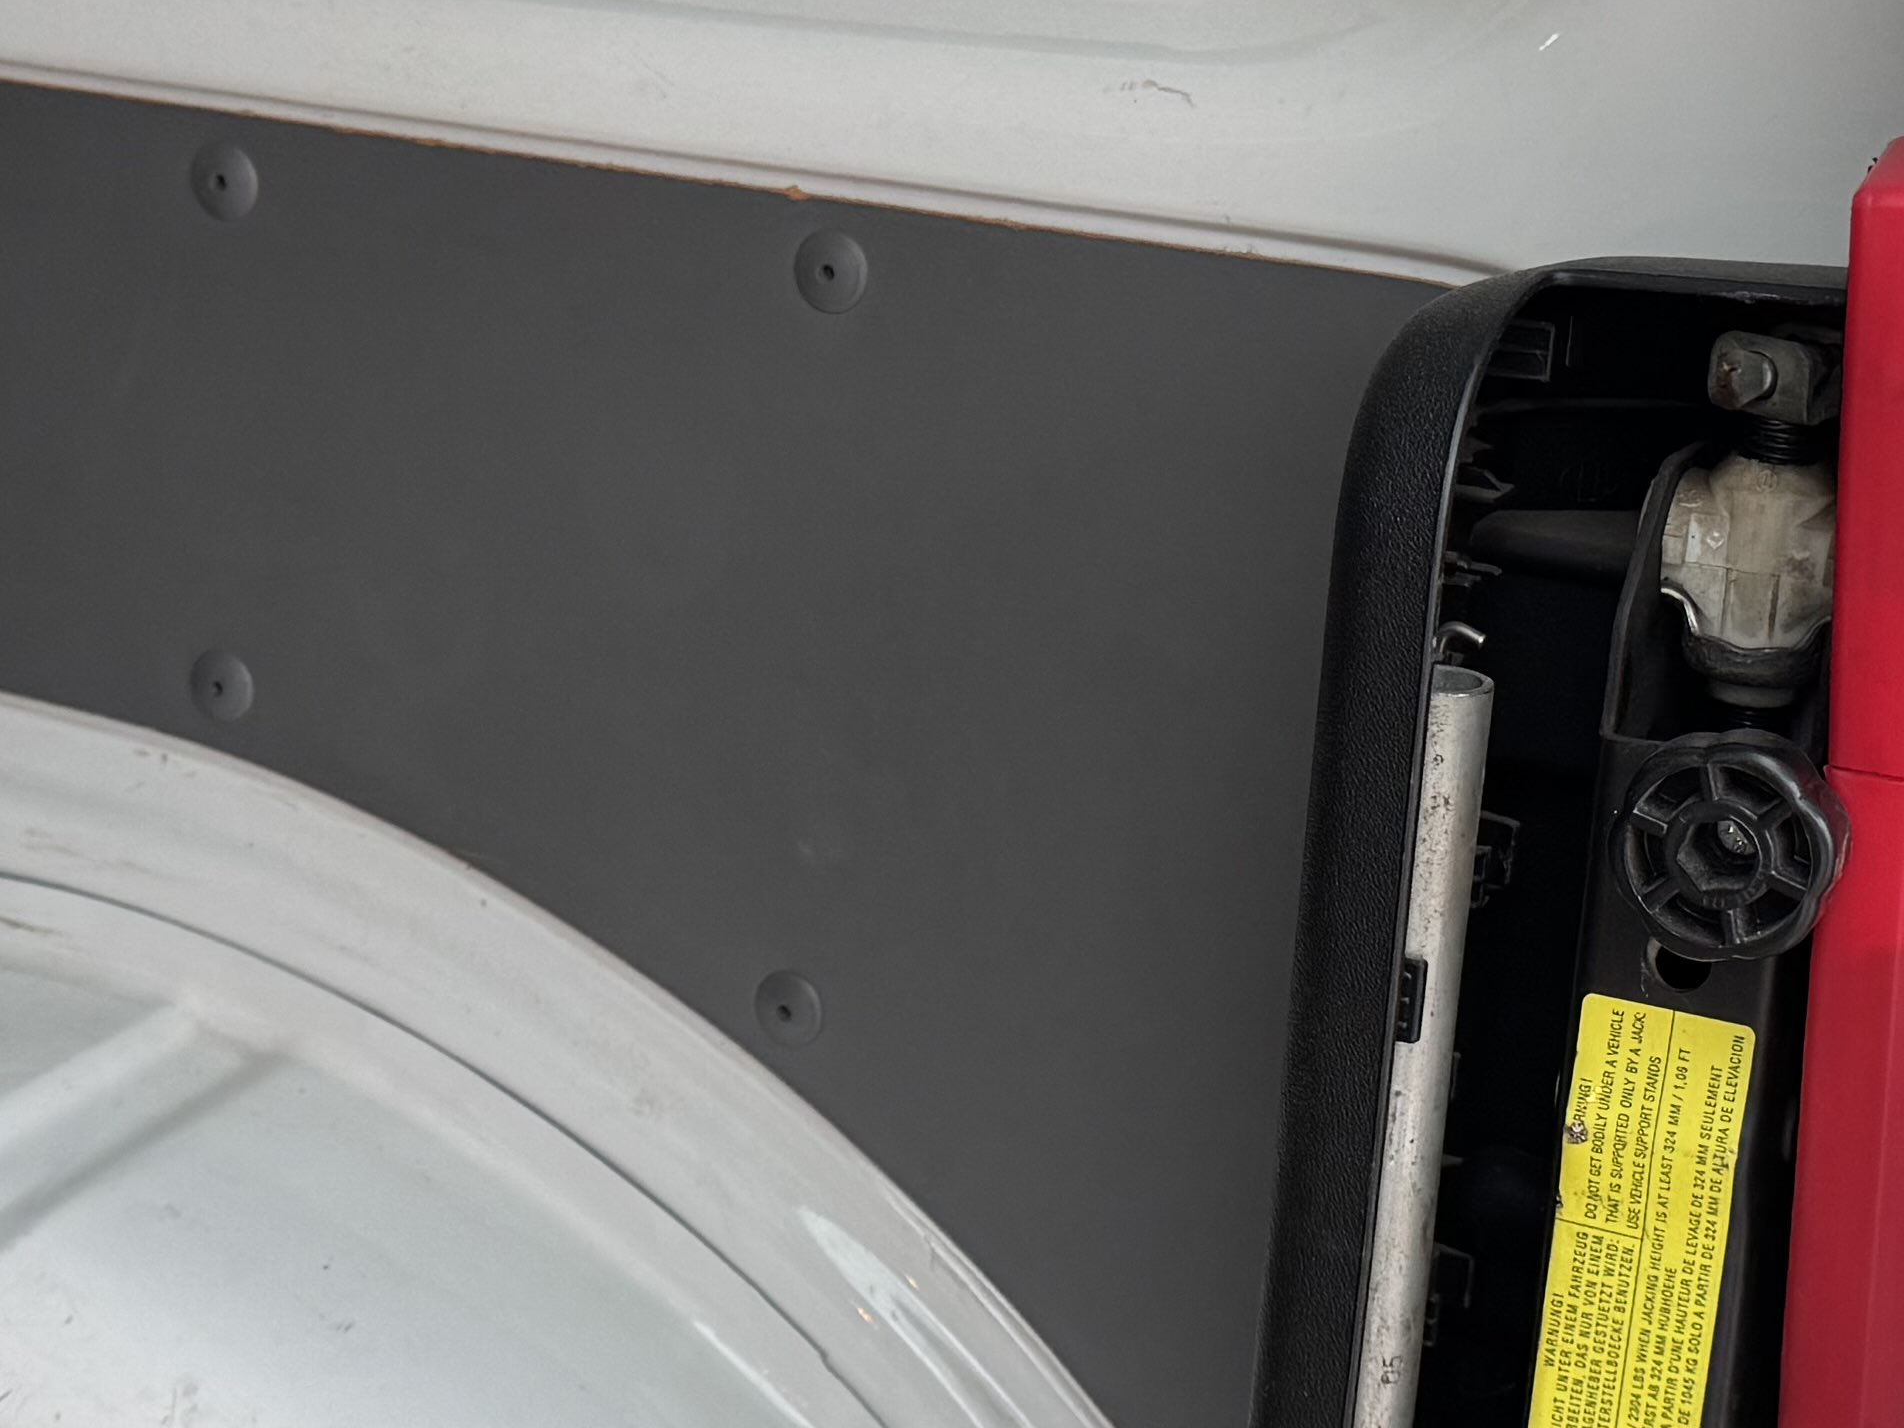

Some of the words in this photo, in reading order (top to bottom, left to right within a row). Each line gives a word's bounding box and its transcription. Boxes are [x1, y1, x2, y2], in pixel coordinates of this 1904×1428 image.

[1606, 1008, 1624, 1055] VEHICLE
[1625, 1057, 1638, 1073] BY
[1677, 1047, 1691, 1062] FT
[1722, 1034, 1745, 1102] ELEVACION
[1596, 1070, 1615, 1110] UNDER
[1619, 1077, 1635, 1108] ONLY
[1642, 1055, 1661, 1102] STANDS
[1667, 1103, 1681, 1125] MM
[1699, 1064, 1722, 1140] SEULEMENT
[1719, 1106, 1733, 1123] DE
[1590, 1112, 1607, 1154] BODILY
[1609, 1112, 1629, 1179] SUPPORTED
[1633, 1104, 1653, 1159] SUPPORT
[1663, 1130, 1676, 1153] 324
[1695, 1143, 1709, 1165] MM
[1711, 1127, 1729, 1175] ALTURA
[1588, 1155, 1602, 1176] GET
[1658, 1154, 1672, 1191] LEAST
[1692, 1169, 1705, 1190] 324
[1586, 1178, 1601, 1201] NOT
[1608, 1182, 1621, 1193] IS
[1628, 1160, 1645, 1204] VEHICLE
[1708, 1177, 1722, 1193] DE
[1583, 1202, 1598, 1219] DO
[1604, 1195, 1620, 1223] THAT
[1656, 1192, 1669, 1209] AT
[1690, 1192, 1703, 1208] DE
[1705, 1195, 1719, 1216] MM
[1626, 1206, 1640, 1229] USE
[1654, 1211, 1667, 1223] IS
[1703, 1219, 1717, 1241] 324
[1684, 1210, 1701, 1255] LEVAGE
[1586, 1234, 1604, 1276] EINEM
[1649, 1225, 1665, 1271] HEIGHT
[1700, 1243, 1715, 1260] DE
[1567, 1231, 1588, 1299] FAHRZEUG
[1612, 1243, 1634, 1313] BENUTZEN.
[1681, 1258, 1695, 1275] DE
[1582, 1279, 1597, 1306] VON
[1657, 1267, 1677, 1331] HUBHOEHE
[1694, 1263, 1712, 1307] PARTIR
[1641, 1274, 1659, 1325] JACKING
[1673, 1278, 1692, 1335] HAUTEUR
[1542, 1292, 1564, 1367] WARNUNG!
[1561, 1303, 1578, 1344] EINEM
[1578, 1311, 1593, 1338] NUR
[1592, 1281, 1613, 1354] GESTUETZT
[1635, 1327, 1651, 1362] WHEN
[1653, 1334, 1666, 1356] MM
[1687, 1321, 1703, 1354] SOLO
[1555, 1348, 1572, 1391] UNTER
[1573, 1343, 1588, 1368] DAS
[1685, 1357, 1698, 1374] KG
[1631, 1366, 1645, 1389] LBS
[1649, 1359, 1663, 1381] 324
[1647, 1383, 1659, 1401] AB
[1660, 1376, 1678, 1421] PARTIR
[1679, 1376, 1695, 1404] 1045
[1677, 1407, 1690, 1425] DE
